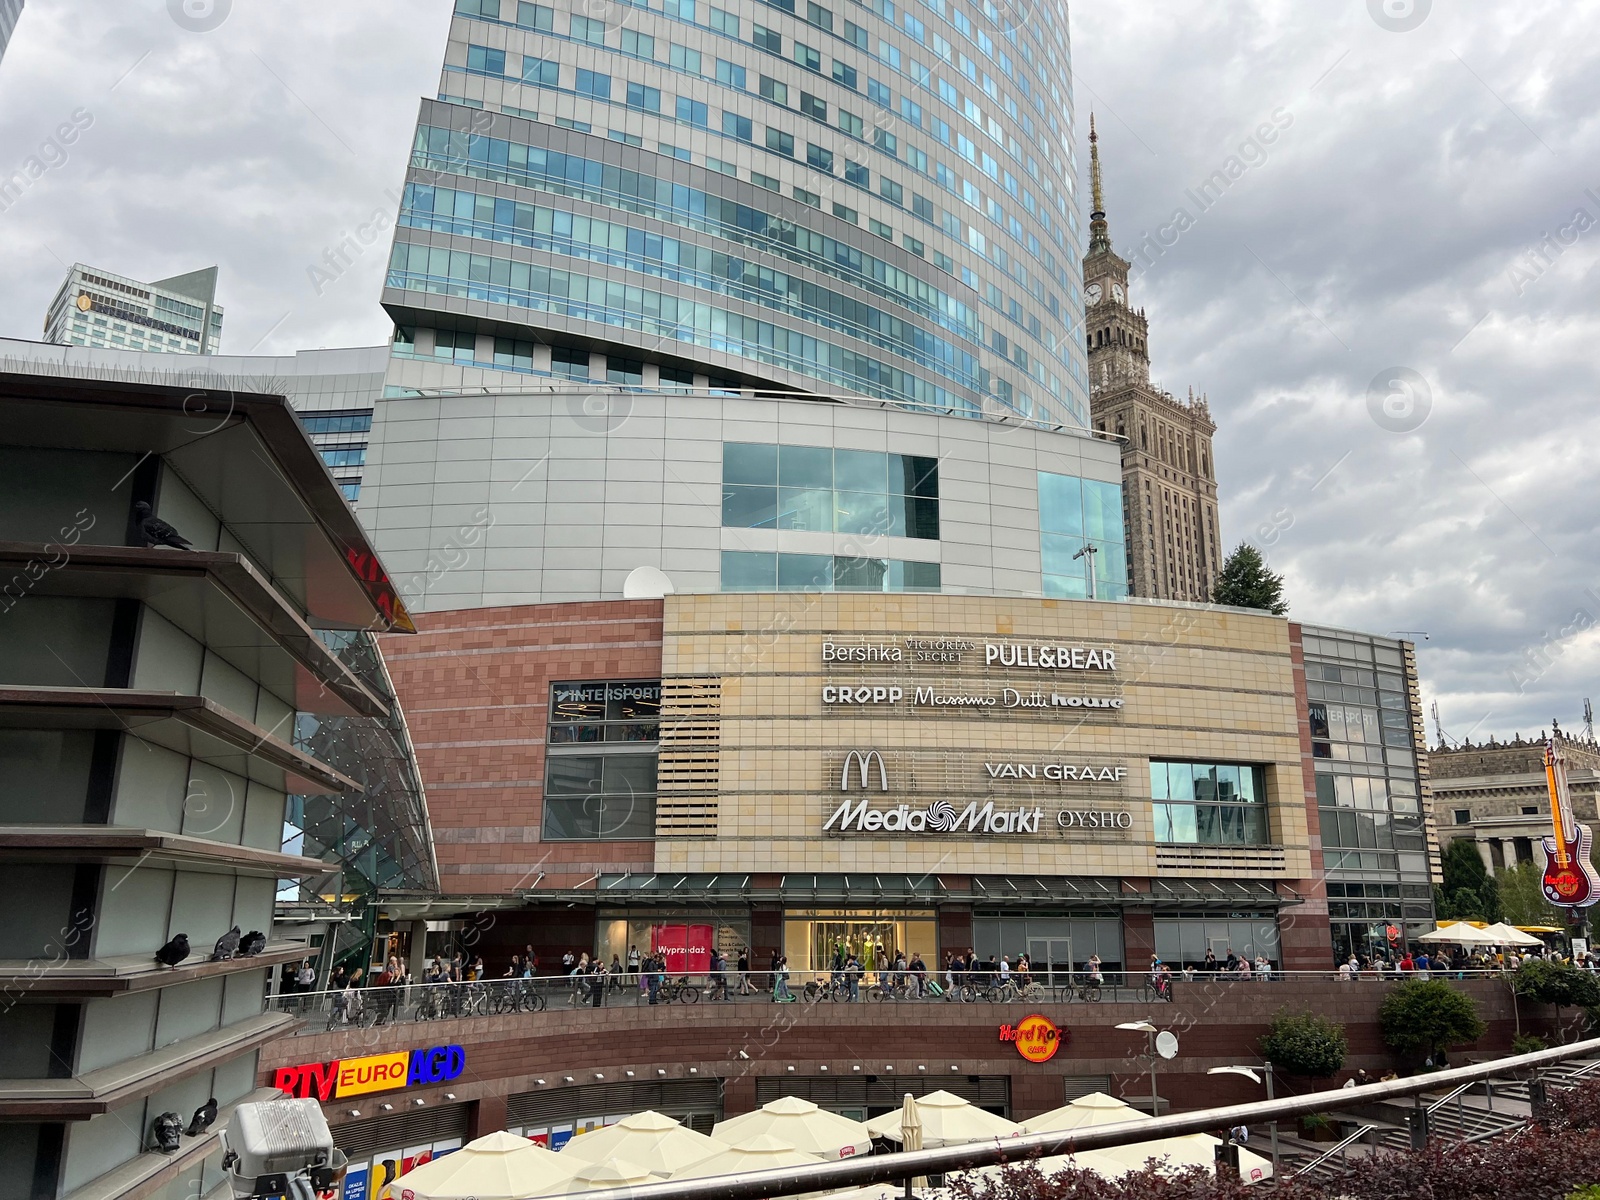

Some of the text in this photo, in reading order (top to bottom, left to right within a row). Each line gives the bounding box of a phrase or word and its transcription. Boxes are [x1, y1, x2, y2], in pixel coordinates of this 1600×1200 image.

[822, 642, 902, 661] Bershka
[904, 639, 976, 650] VICTORIA'S
[917, 651, 963, 662] SECRET
[985, 644, 1117, 671] PULL&BEAR
[571, 686, 661, 702] INTERSPORT
[822, 686, 902, 704] CROPP
[914, 686, 1050, 708] Massimo Dutti
[1051, 693, 1126, 709] house
[1314, 708, 1373, 726] INTERSPORT
[985, 763, 1128, 782] VAN GRAAF
[1057, 810, 1133, 829] OYSHO
[658, 946, 705, 955] Wyprzedaż
[1000, 1024, 1036, 1042] Hard
[1028, 1046, 1047, 1054] CAFE
[275, 1060, 340, 1100] RTV
[340, 1062, 405, 1087] EURO
[406, 1044, 466, 1087] AGD
